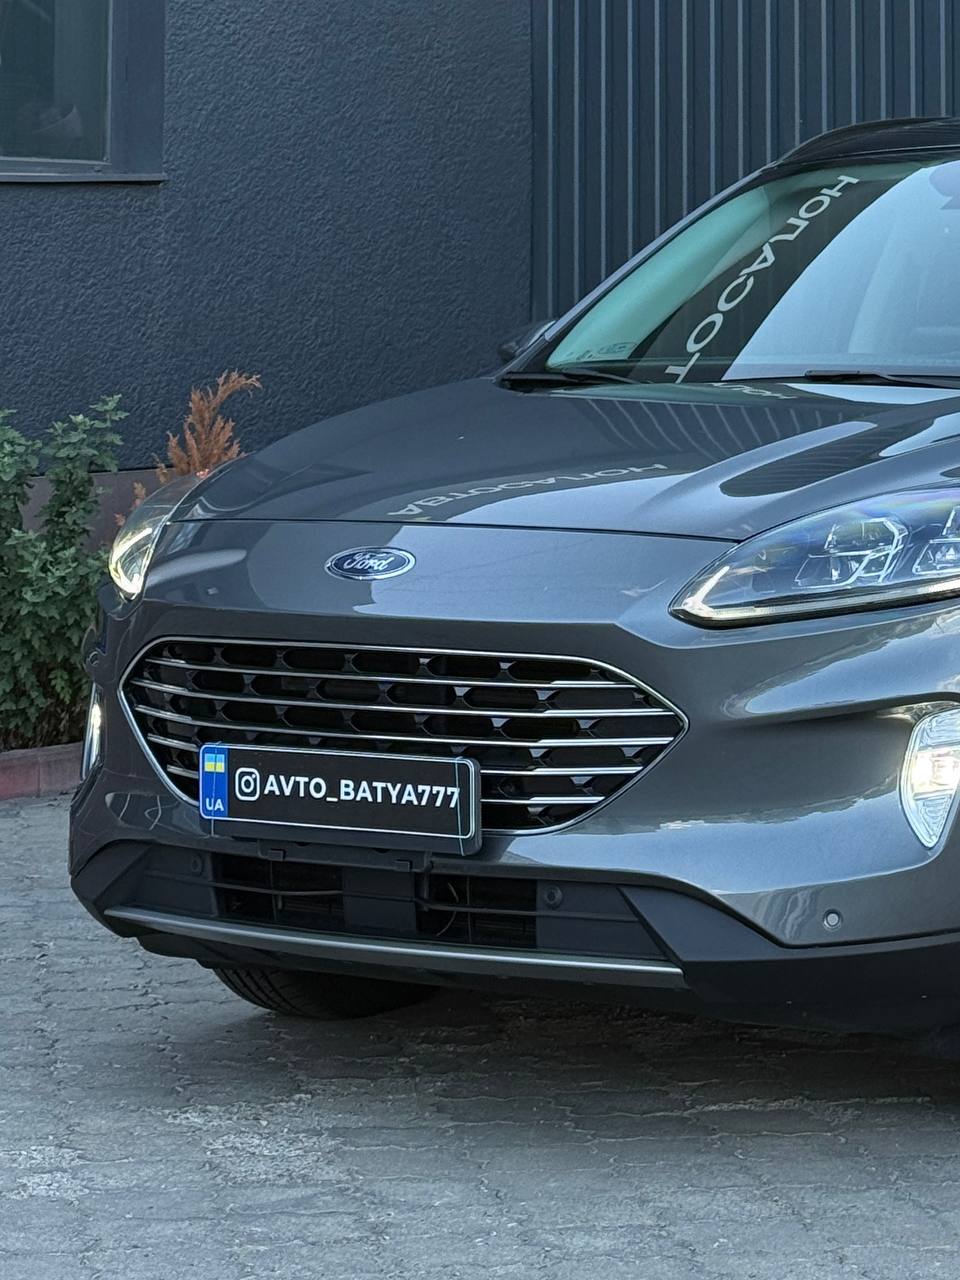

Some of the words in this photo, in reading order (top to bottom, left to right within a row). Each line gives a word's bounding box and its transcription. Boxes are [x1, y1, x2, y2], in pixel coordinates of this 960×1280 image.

[343, 551, 395, 571] Ford
[263, 774, 461, 809] AVTO_BATYA777
[205, 797, 224, 812] UA
